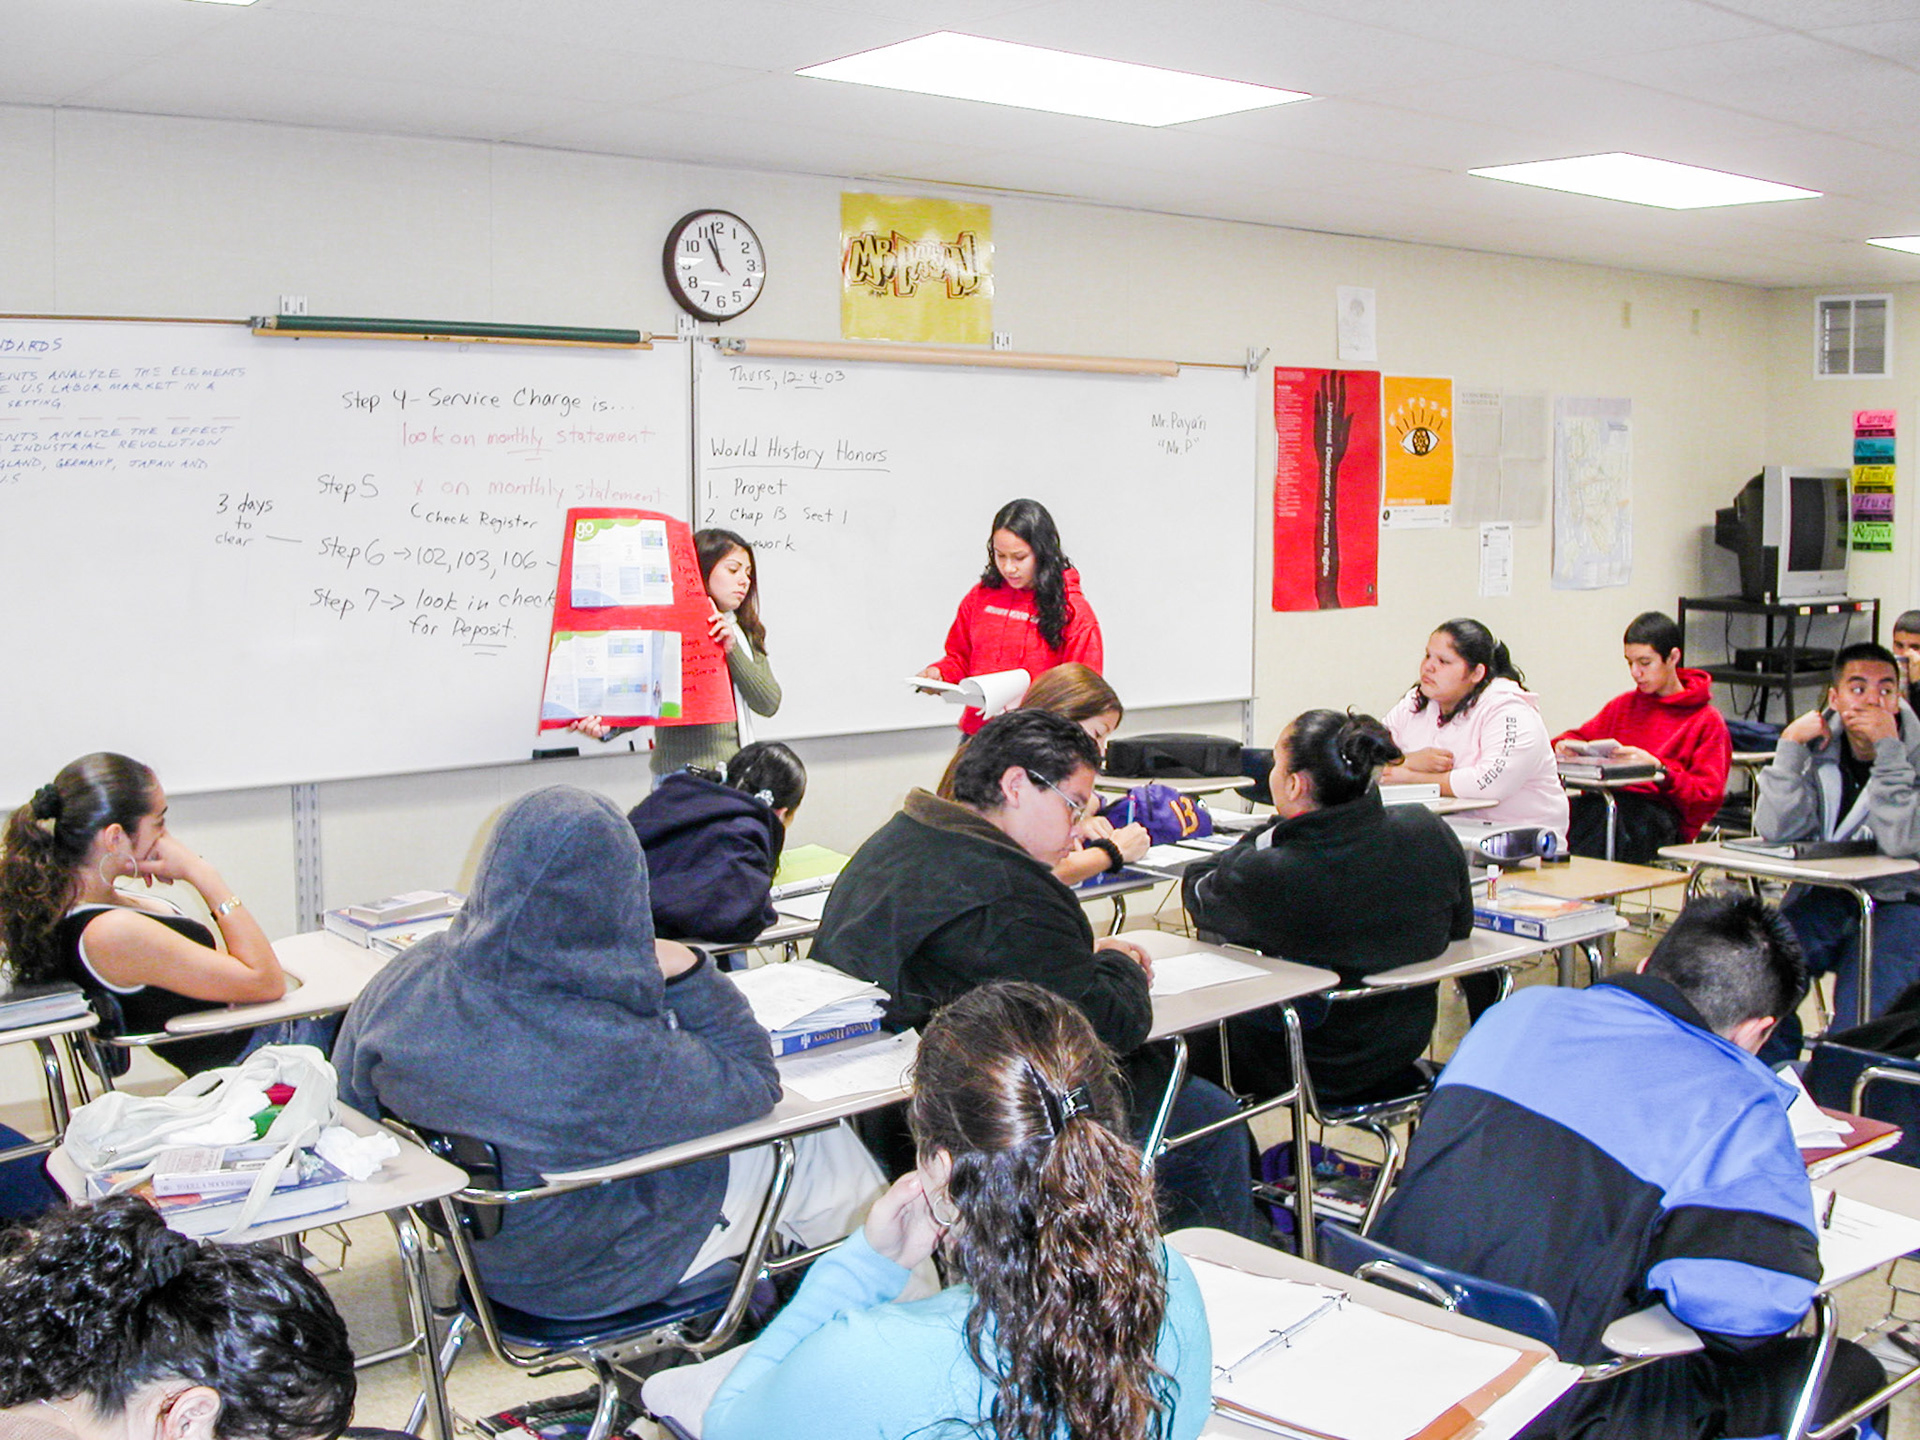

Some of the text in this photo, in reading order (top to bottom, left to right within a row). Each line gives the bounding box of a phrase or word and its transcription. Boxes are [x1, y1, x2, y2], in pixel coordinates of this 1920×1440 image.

[686, 240, 700, 253] 10
[741, 241, 751, 254] 2
[746, 259, 756, 272] 3
[688, 276, 698, 289] 8
[742, 278, 752, 287] 4
[701, 290, 710, 302] 7
[716, 295, 726, 308] 6
[732, 291, 742, 303] 5
[48, 368, 121, 381] ANALYZE
[135, 366, 161, 377] THE
[171, 366, 247, 378] ELEMENTS
[51, 383, 101, 394] LABOR
[109, 381, 179, 392] MARKET
[206, 381, 216, 392] A
[342, 391, 380, 412] Step
[513, 387, 582, 417] Charge
[49, 428, 121, 441] ANALYZE
[131, 427, 159, 437] THE
[171, 425, 236, 436] EFFECT
[402, 422, 656, 450] look on monthly statement
[11, 441, 107, 453] INDUSTRIAL
[118, 437, 223, 450] REVOLUTION
[711, 436, 887, 469] World History Honors
[129, 459, 177, 470] JAPAN
[181, 458, 209, 470] AND
[317, 475, 355, 502] Step
[441, 481, 471, 496] on
[488, 474, 565, 508] monthly
[575, 477, 667, 504] statement
[734, 478, 788, 502] Project
[1322, 401, 1334, 577] Universal Declaration of Human Rights
[217, 492, 274, 515] 3 days
[235, 516, 252, 532] to
[480, 506, 539, 531] Register
[730, 507, 763, 527] Chap
[214, 531, 256, 547] clear
[576, 522, 594, 540] go
[313, 588, 355, 620] Step
[365, 588, 381, 612] 7
[415, 591, 458, 611] look
[467, 592, 489, 612] in
[409, 614, 439, 638] for
[1477, 758, 1506, 791] SPORT
